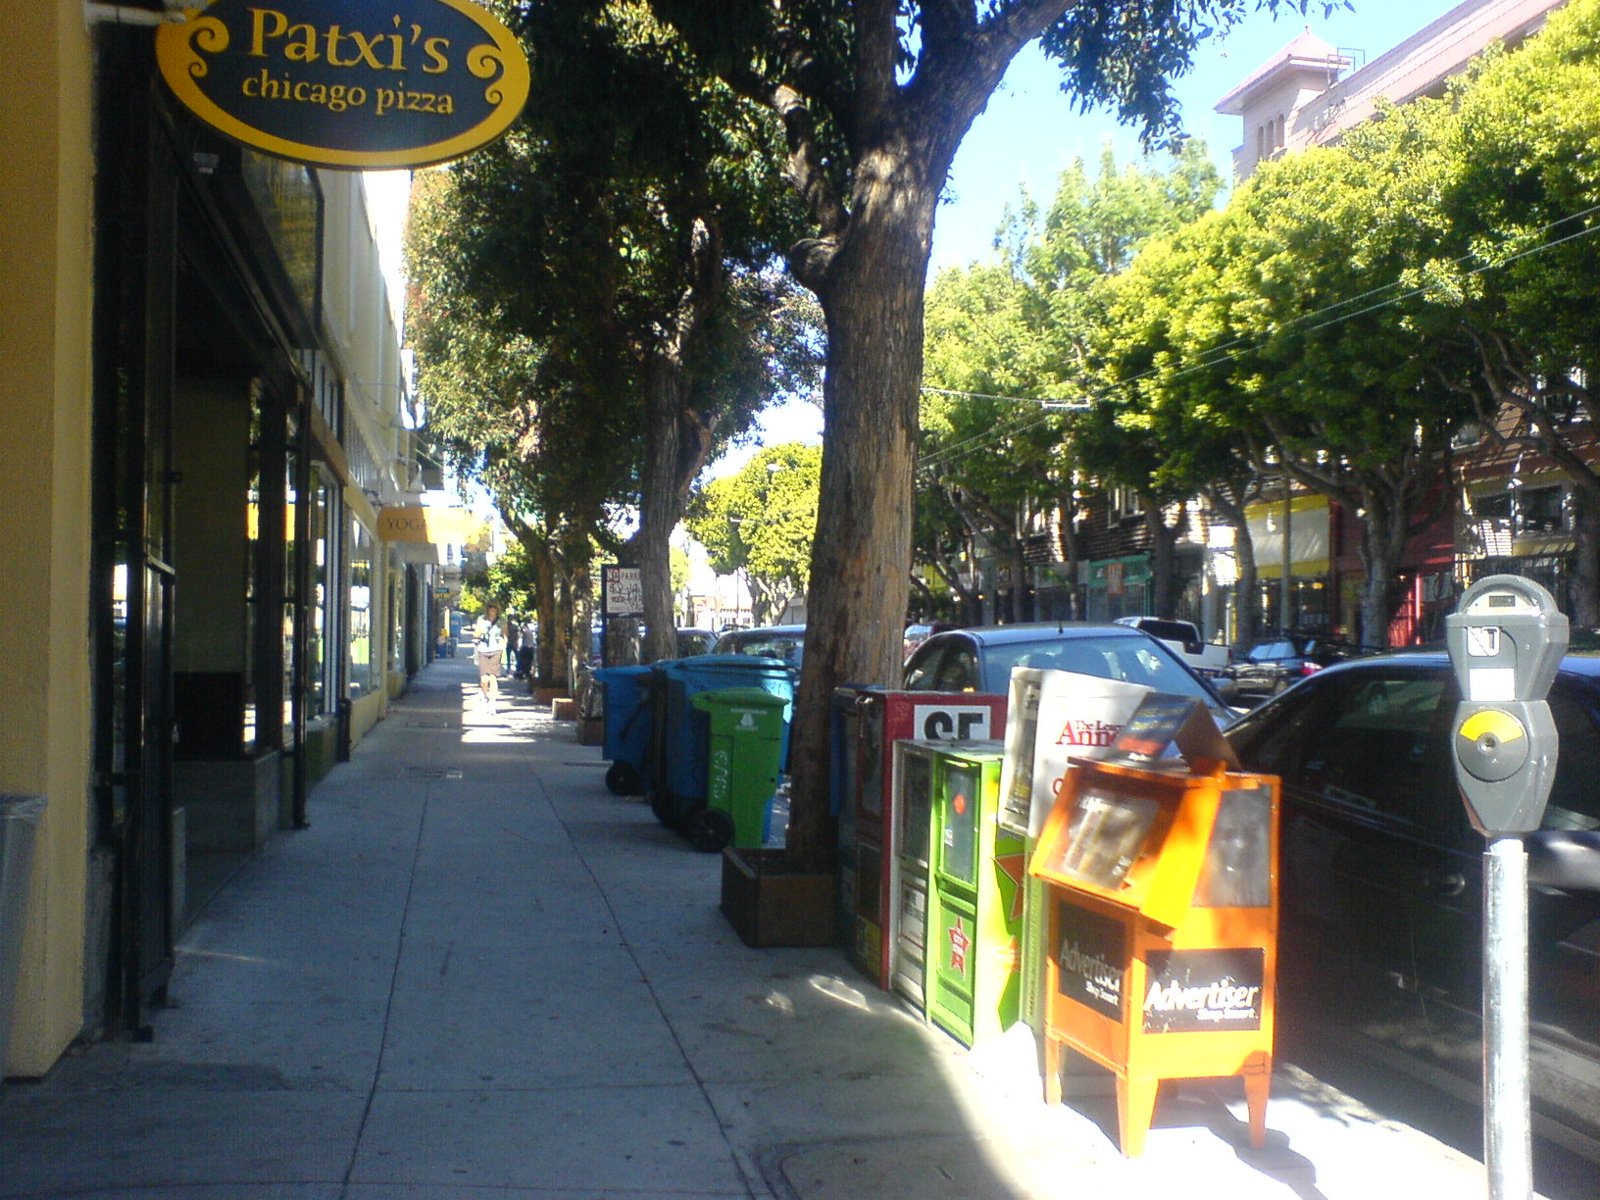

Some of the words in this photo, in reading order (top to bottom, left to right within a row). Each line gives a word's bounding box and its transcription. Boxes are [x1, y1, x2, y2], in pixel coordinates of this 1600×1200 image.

[247, 7, 450, 74] Patxi's
[242, 69, 367, 112] chicago
[375, 81, 454, 116] pizza
[1143, 974, 1260, 1012] Advertiser
